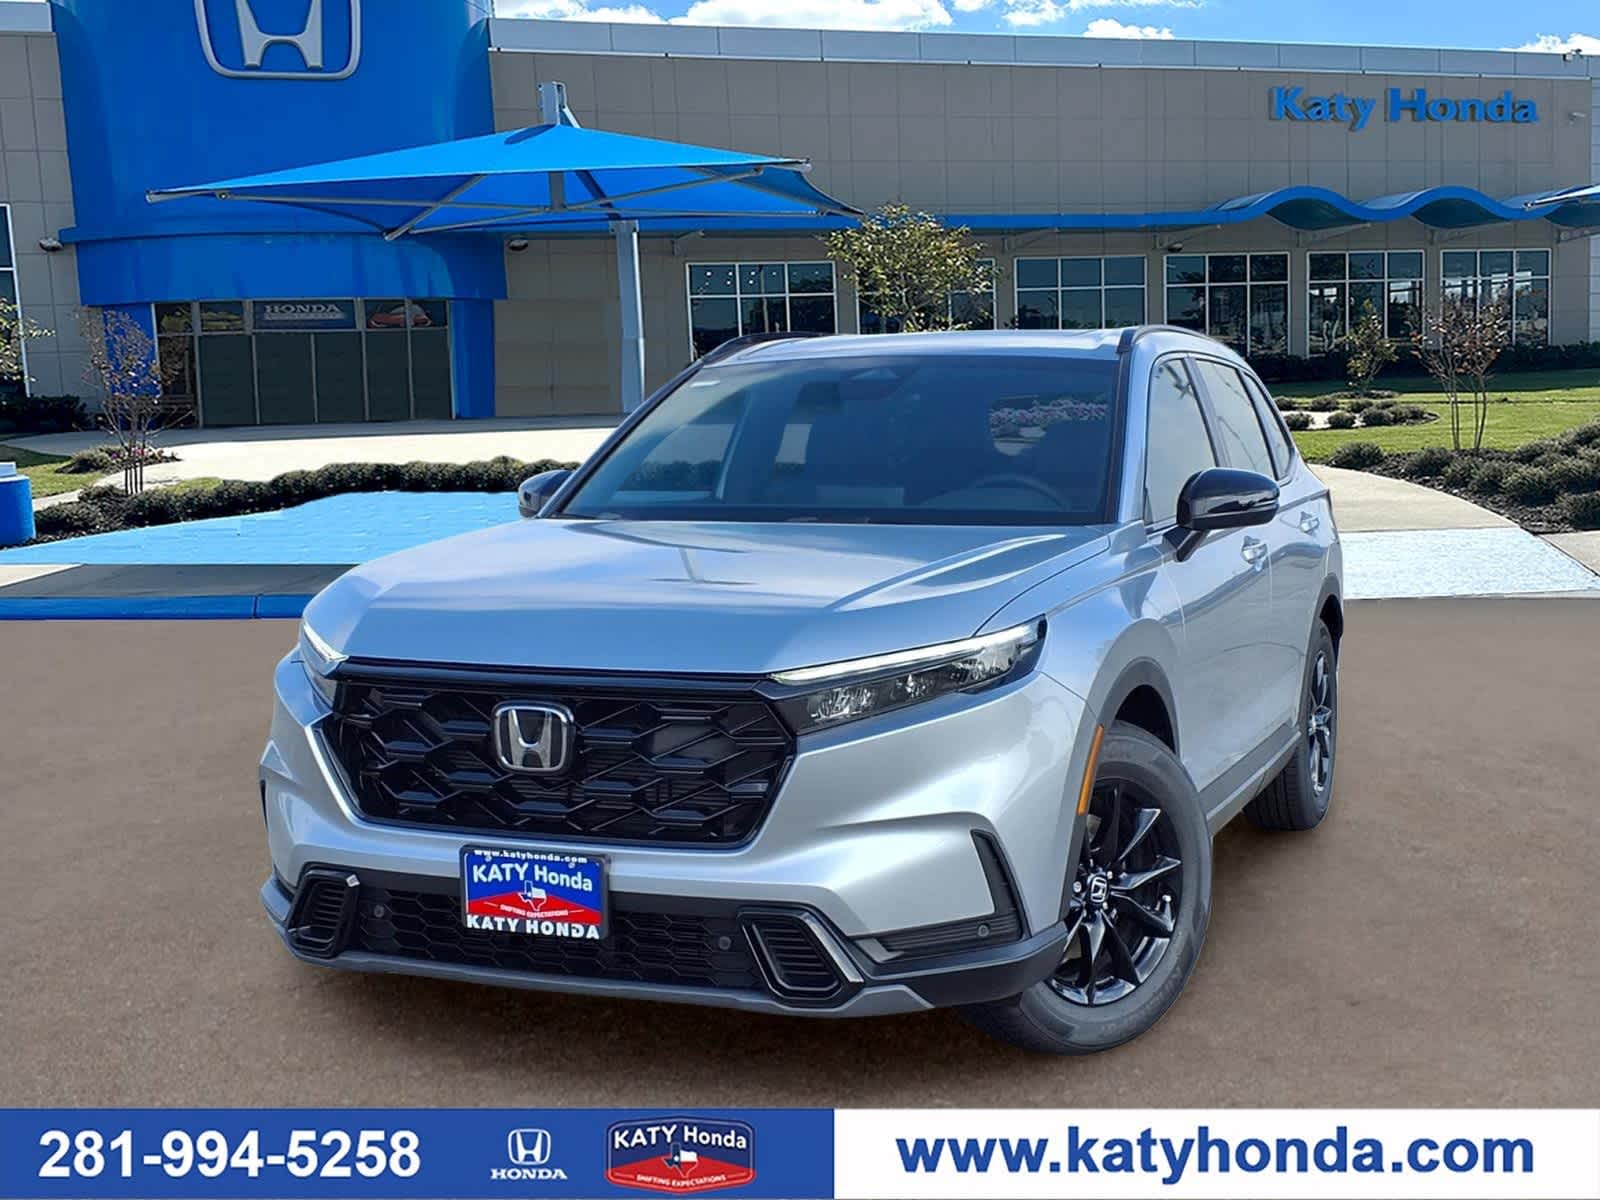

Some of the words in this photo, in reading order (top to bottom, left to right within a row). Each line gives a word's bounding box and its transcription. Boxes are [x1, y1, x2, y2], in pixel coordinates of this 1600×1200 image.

[1270, 86, 1377, 131] Katy
[1386, 87, 1540, 123] Honda
[264, 304, 342, 313] HONDA
[474, 849, 587, 863] www.katyhonda.com
[472, 862, 529, 883] KATY
[534, 865, 593, 892] Honda
[466, 914, 520, 933] KATY
[526, 919, 600, 940] HONDA
